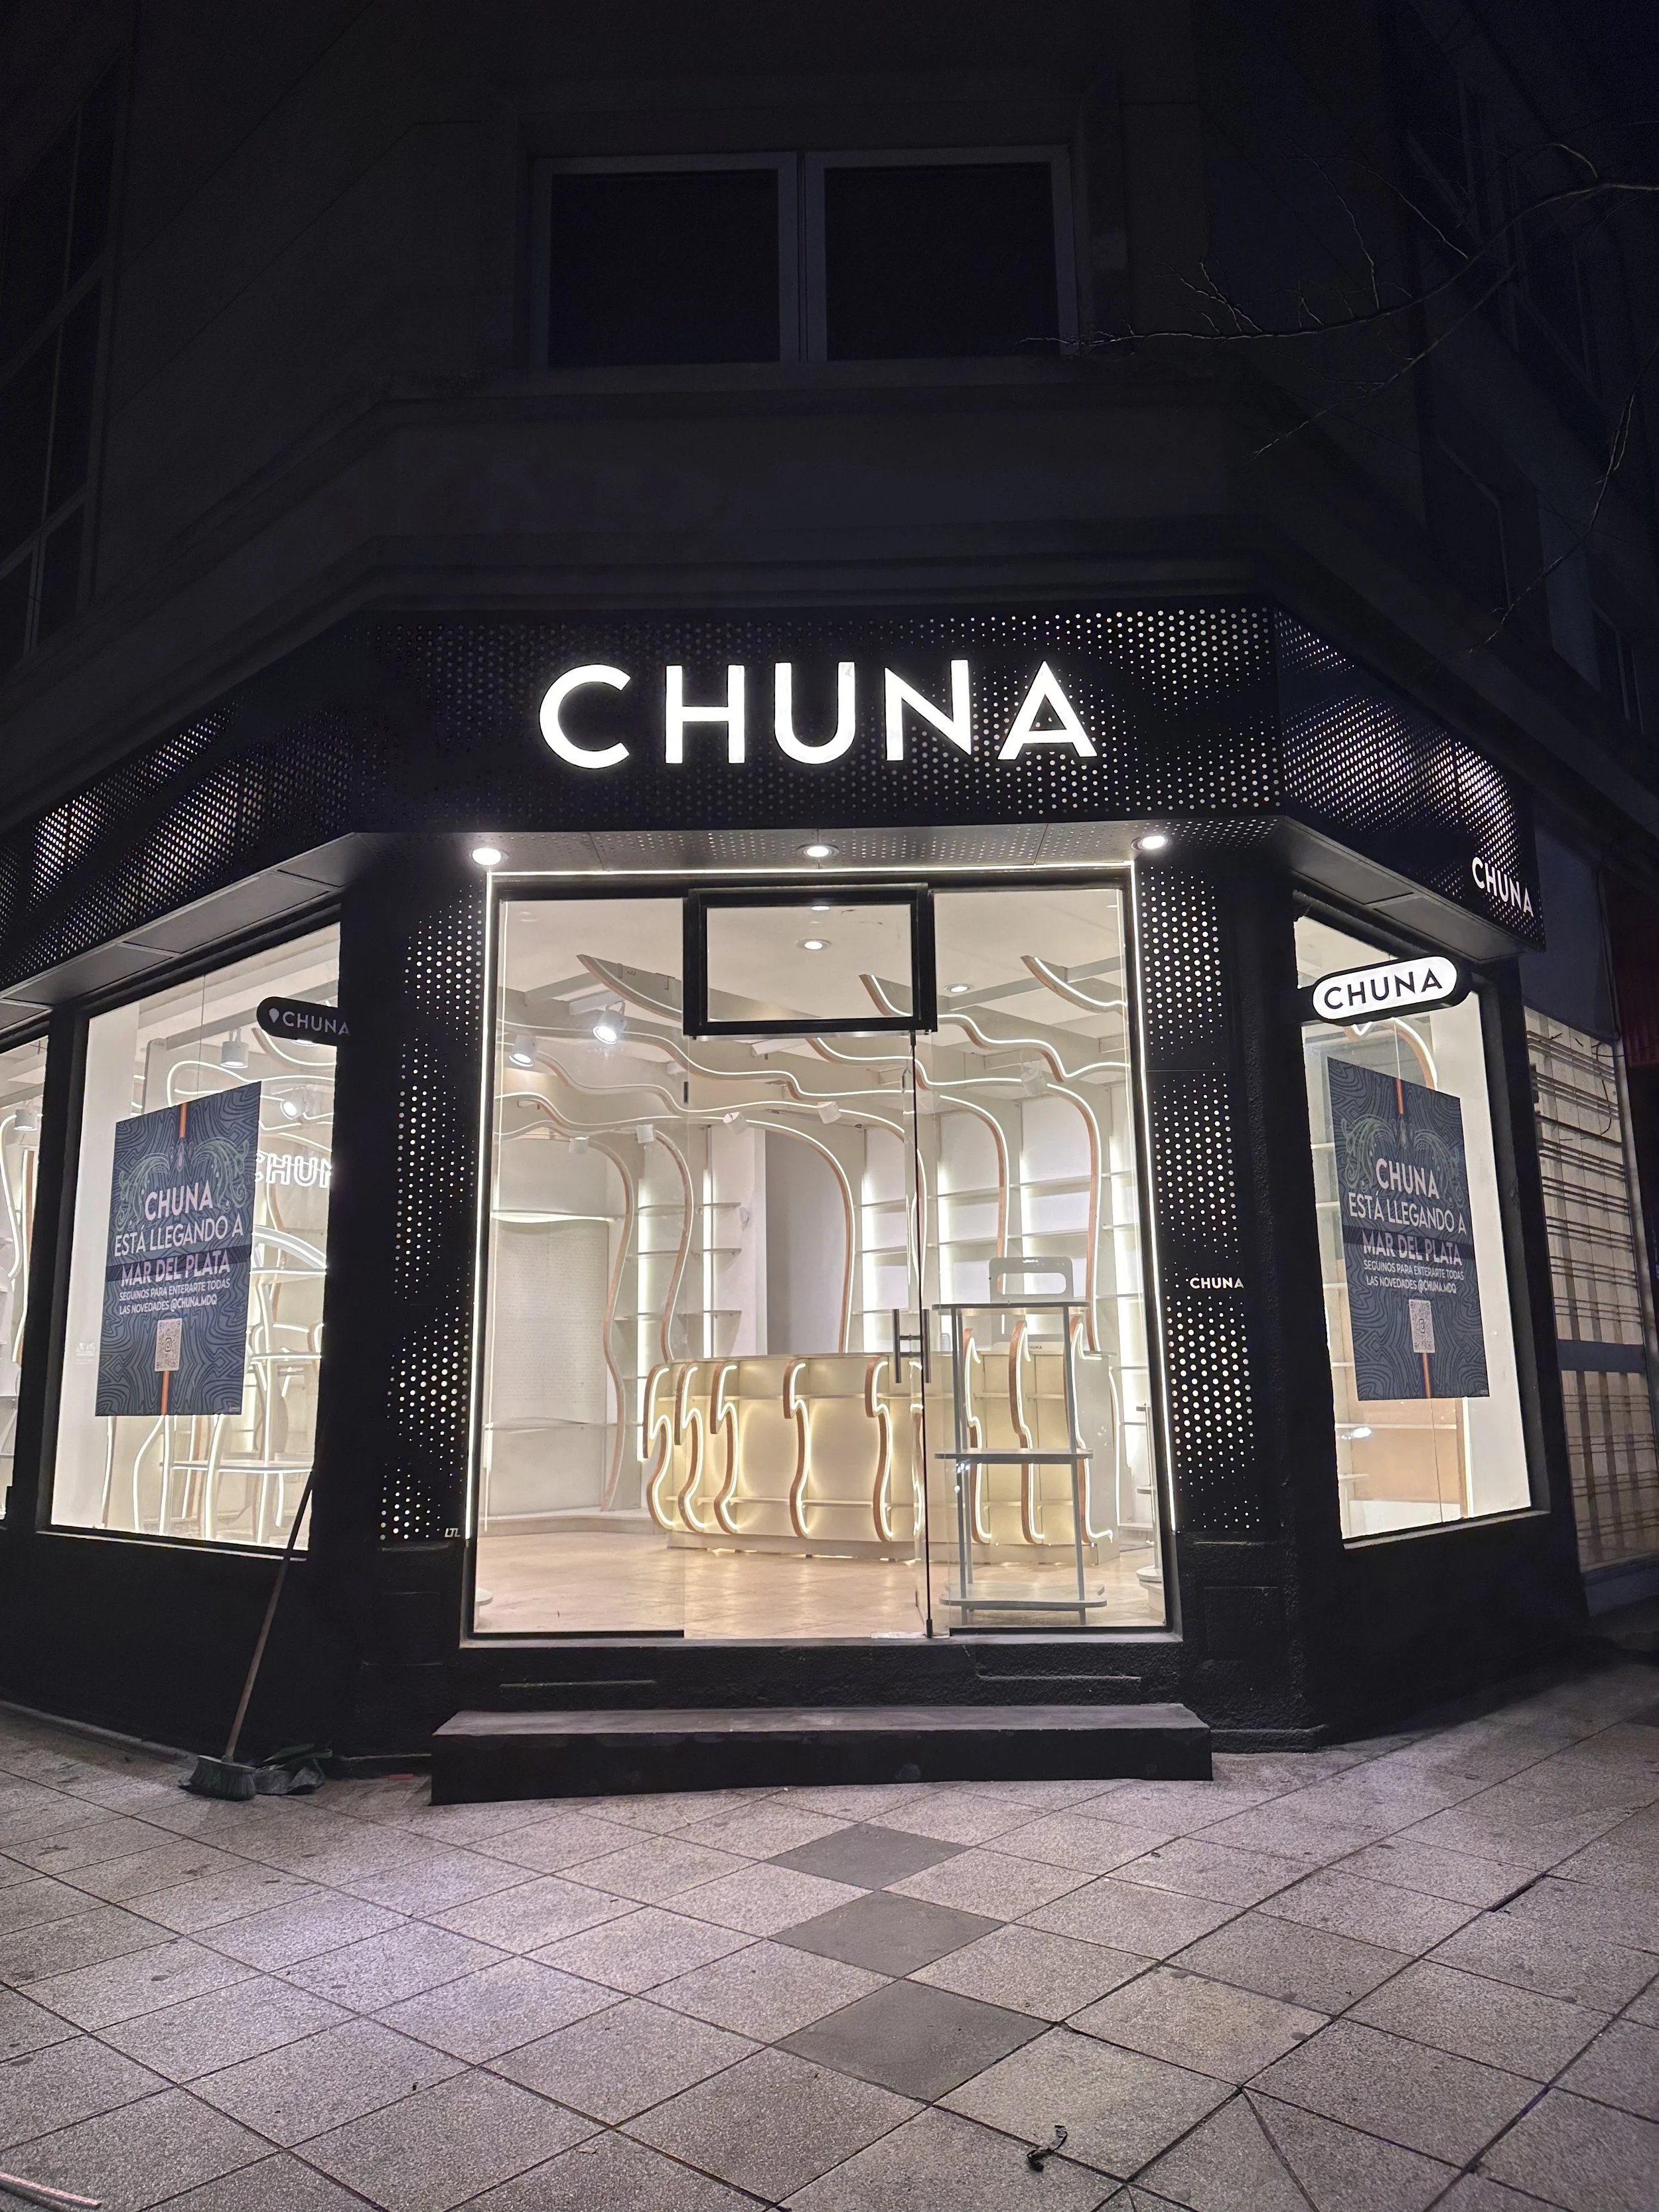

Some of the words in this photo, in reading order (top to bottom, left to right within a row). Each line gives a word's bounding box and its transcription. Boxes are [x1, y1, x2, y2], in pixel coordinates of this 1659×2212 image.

[538, 658, 1098, 769] CHUNA
[1471, 856, 1534, 918] CHUNA
[1324, 968, 1443, 1009] CHUNA
[282, 1011, 350, 1036] CHUNA
[1376, 1158, 1440, 1199] CHUNA
[145, 1180, 213, 1220] CHUNA
[1348, 1191, 1384, 1221] ESTÁ
[1386, 1199, 1455, 1232] LLEGANDO
[1458, 1213, 1467, 1235] A
[114, 1224, 146, 1257] ESTÁ
[149, 1215, 228, 1251] LLEGANDO
[232, 1213, 244, 1237] A
[1362, 1228, 1396, 1257] MAR
[1398, 1234, 1423, 1261] DEL
[1425, 1239, 1463, 1266] PLATA
[121, 1260, 151, 1287] MAR
[155, 1256, 181, 1282] DEL
[184, 1249, 230, 1278] PLATA
[1190, 1277, 1244, 1289] CHUNA
[1364, 1260, 1396, 1273] SEGUINOS
[1396, 1264, 1413, 1275] PARA
[1413, 1266, 1445, 1279] ENTERARTE
[1446, 1269, 1465, 1280] TODAS
[1366, 1276, 1378, 1286] LAS
[1380, 1276, 1417, 1290] NOVEDADES
[119, 1288, 150, 1301] SEGUINOS
[150, 1286, 167, 1297] PARA
[168, 1282, 206, 1295] ENTERARTE
[206, 1278, 230, 1290] TODAS
[119, 1304, 131, 1315] LAS
[131, 1300, 169, 1314] NOVEDADES
